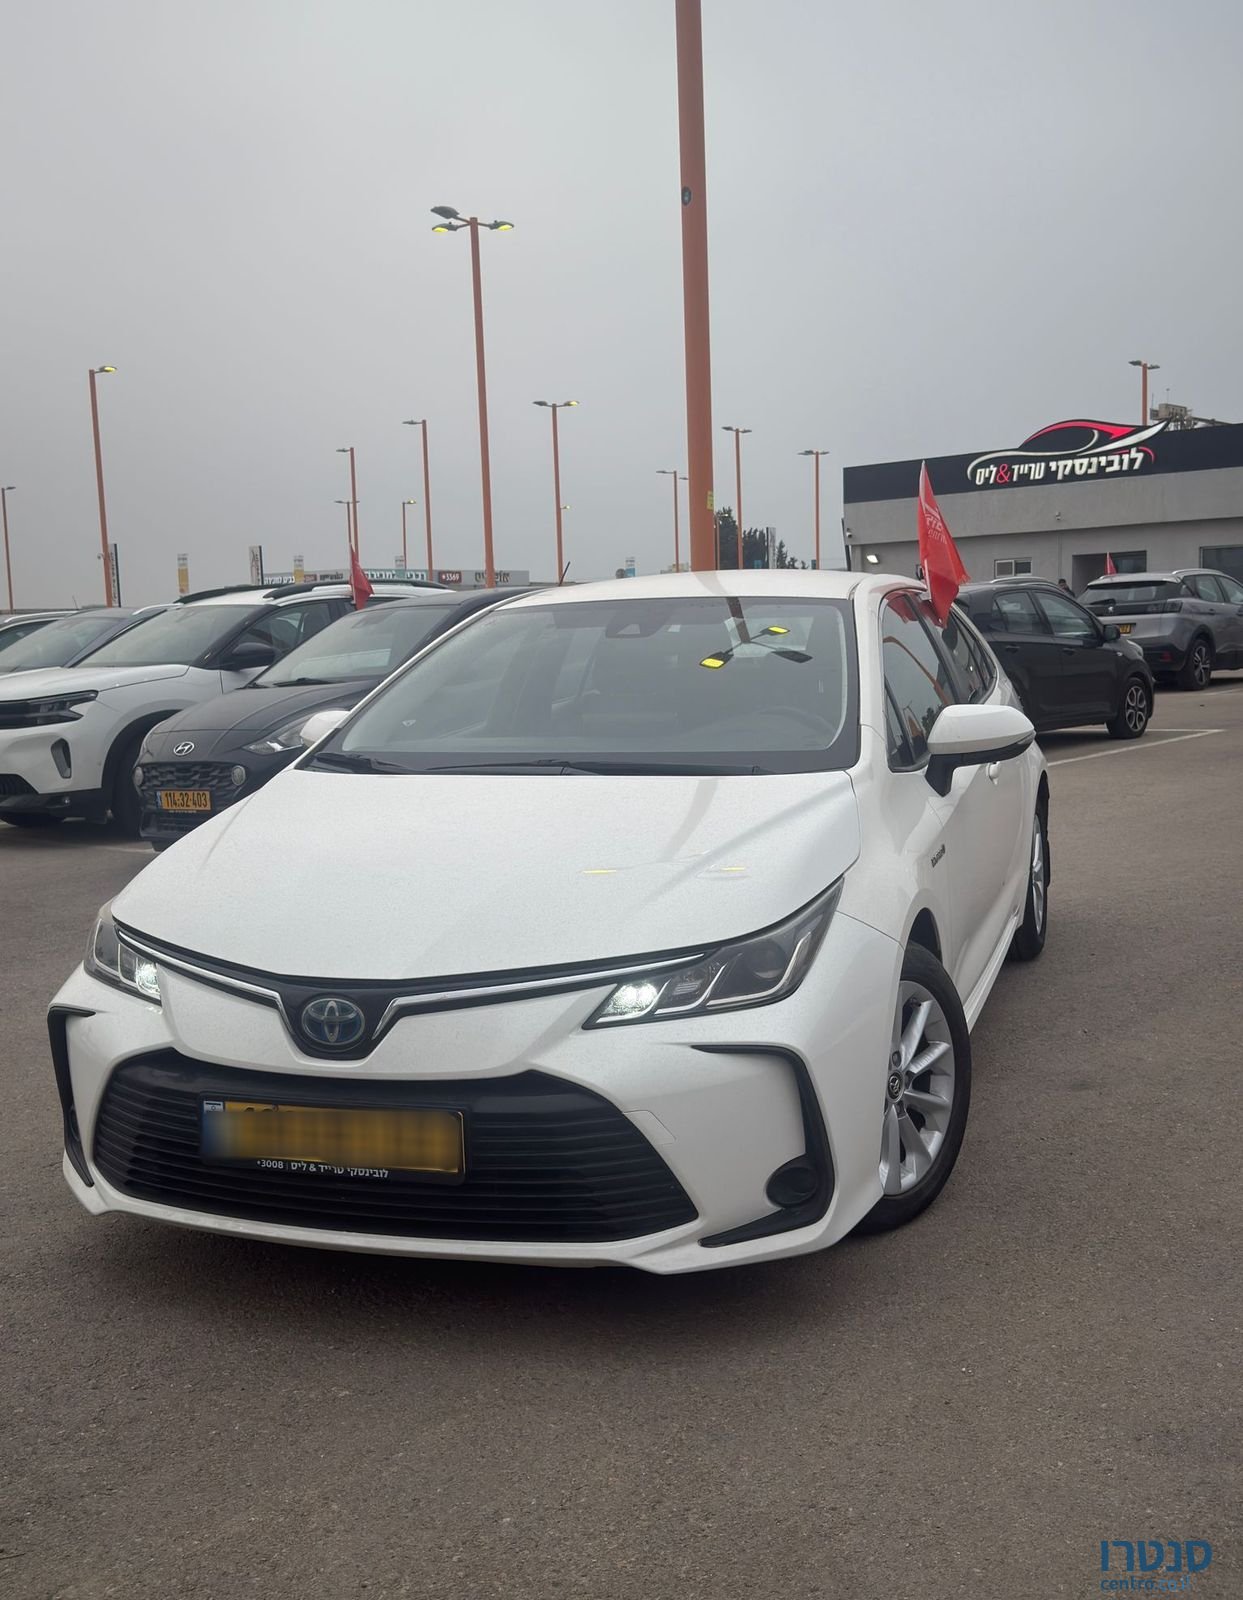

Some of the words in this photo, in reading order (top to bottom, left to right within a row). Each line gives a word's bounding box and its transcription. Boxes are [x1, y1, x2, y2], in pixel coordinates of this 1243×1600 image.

[1049, 447, 1144, 480] לובינסקי
[291, 1162, 307, 1170] ליס
[309, 1163, 316, 1172] &
[319, 1164, 344, 1174] טרייד
[347, 1167, 389, 1178] לובינסקי
